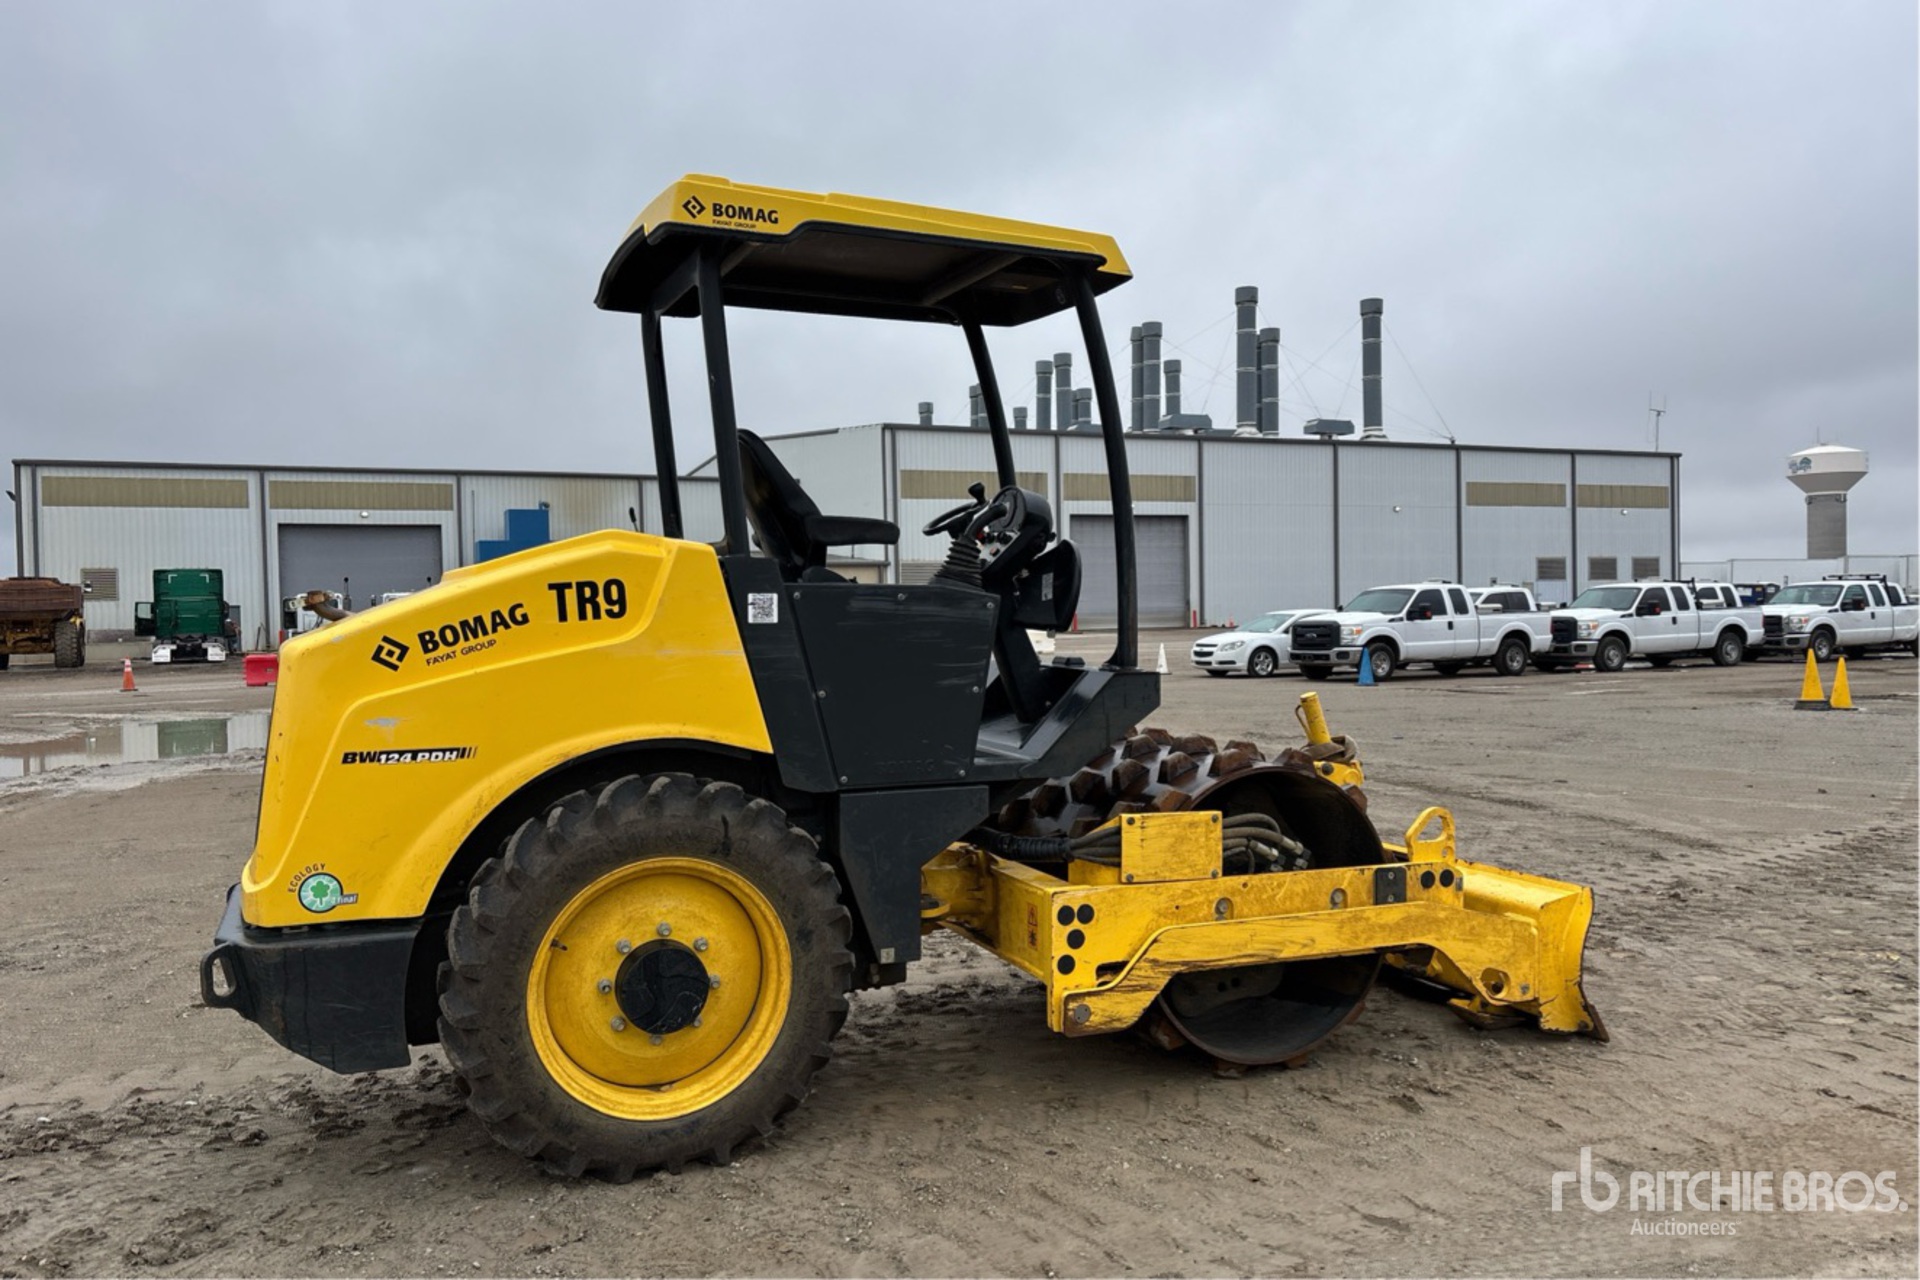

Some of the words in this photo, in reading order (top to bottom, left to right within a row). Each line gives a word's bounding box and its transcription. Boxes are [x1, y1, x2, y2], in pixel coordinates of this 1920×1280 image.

[712, 203, 779, 224] BOMAG
[547, 578, 627, 623] TR9
[417, 603, 530, 655] BOMAG
[425, 650, 457, 667] FAYAT
[461, 639, 497, 657] GROUP
[415, 750, 458, 763] PDH
[287, 863, 326, 893] ECOLOGY
